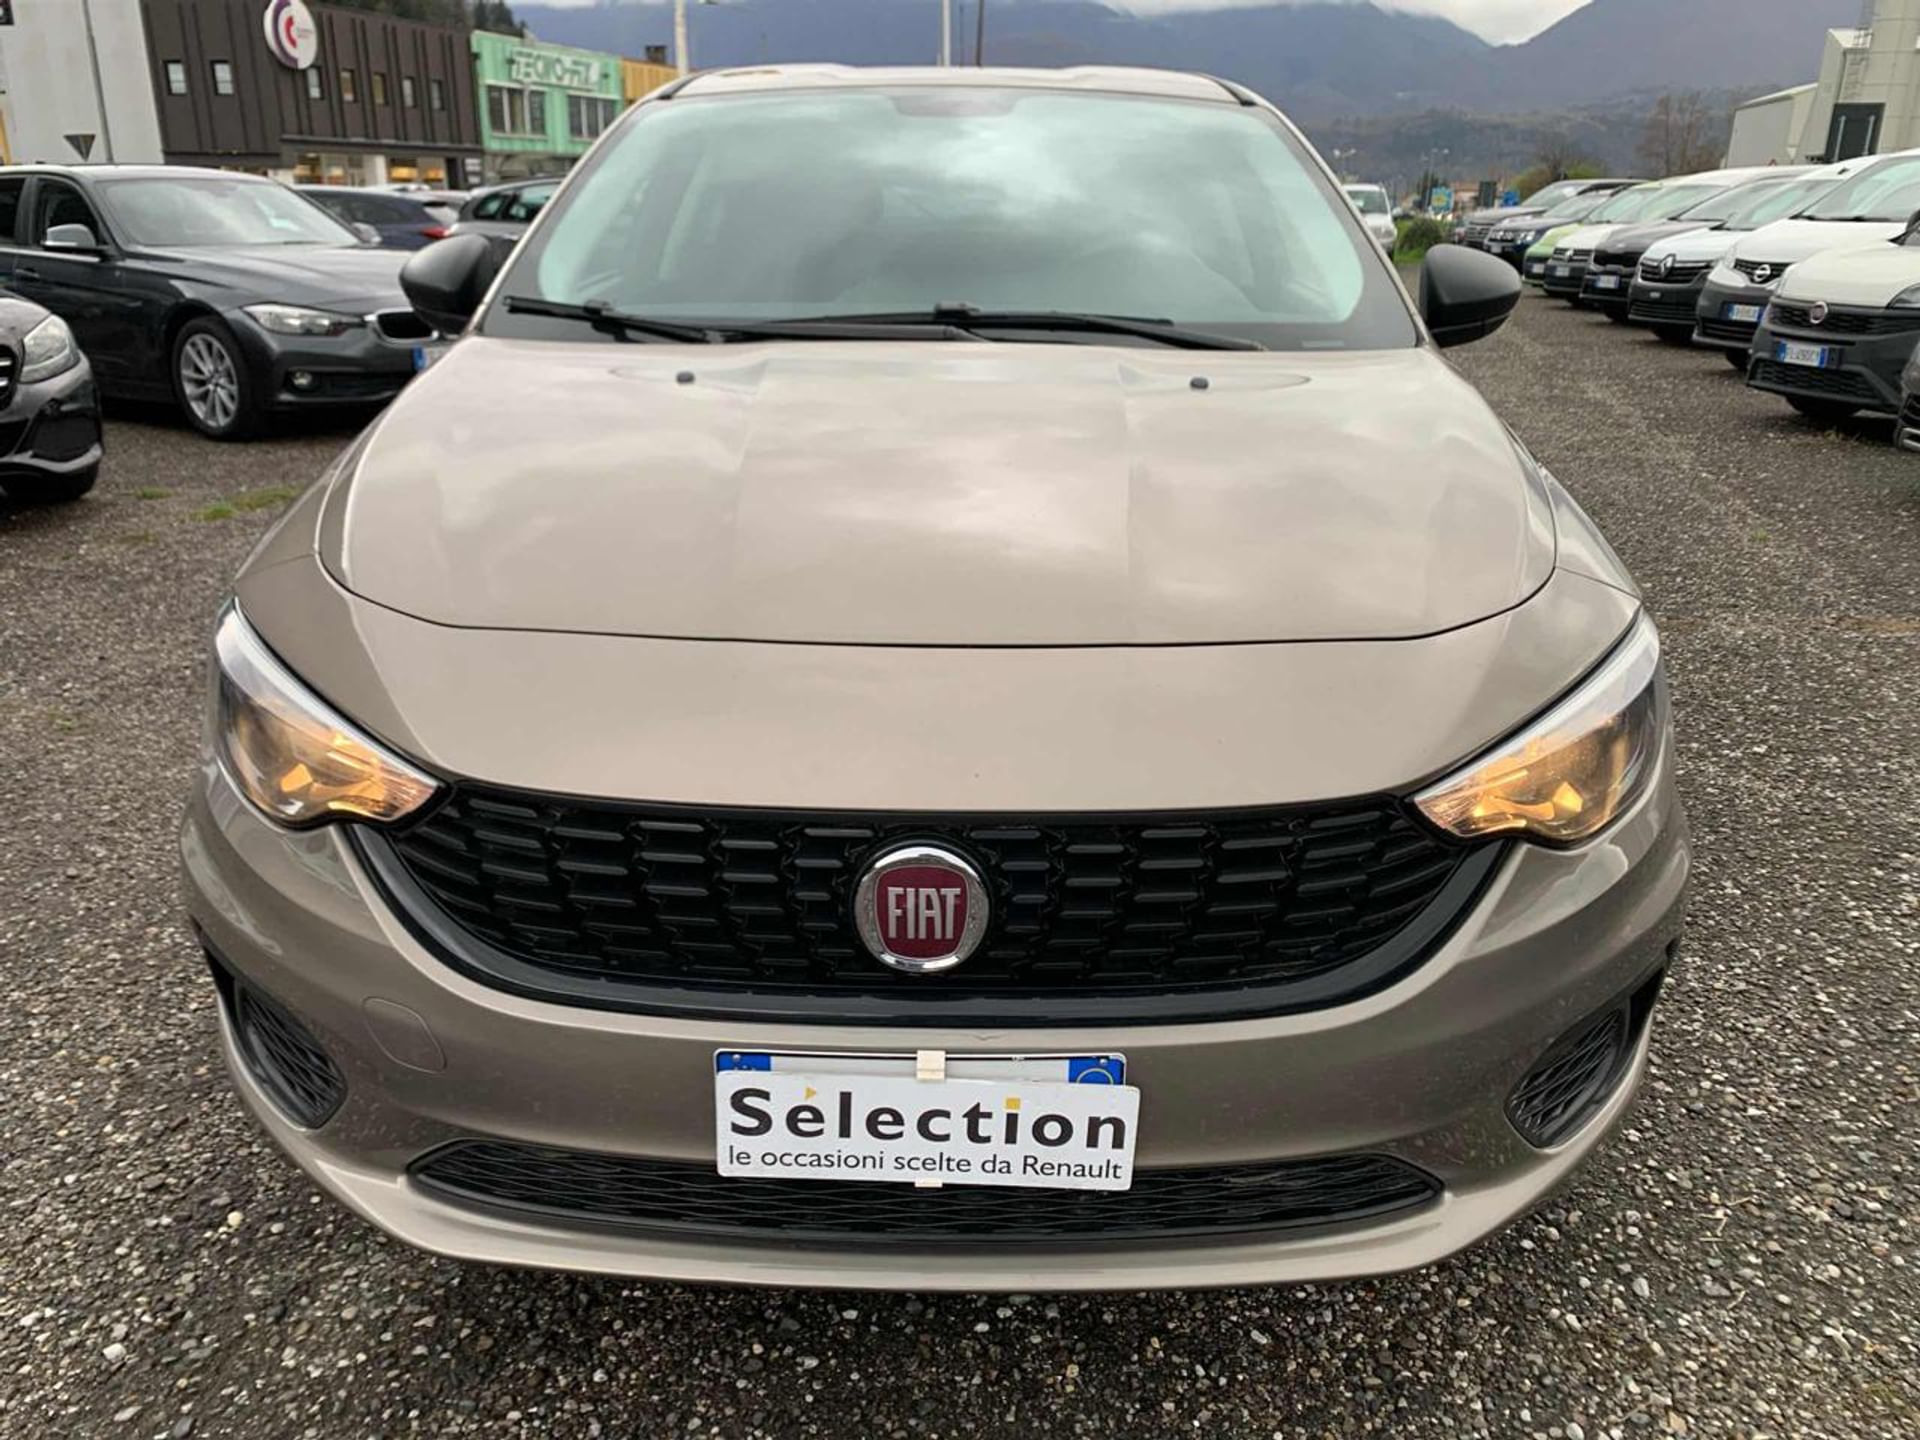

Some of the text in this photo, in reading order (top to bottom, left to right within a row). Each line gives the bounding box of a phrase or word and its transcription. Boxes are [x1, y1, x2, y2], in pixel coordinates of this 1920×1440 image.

[887, 886, 962, 940] FIAT
[728, 1145, 1123, 1180] le occasioni scelte da Renault
